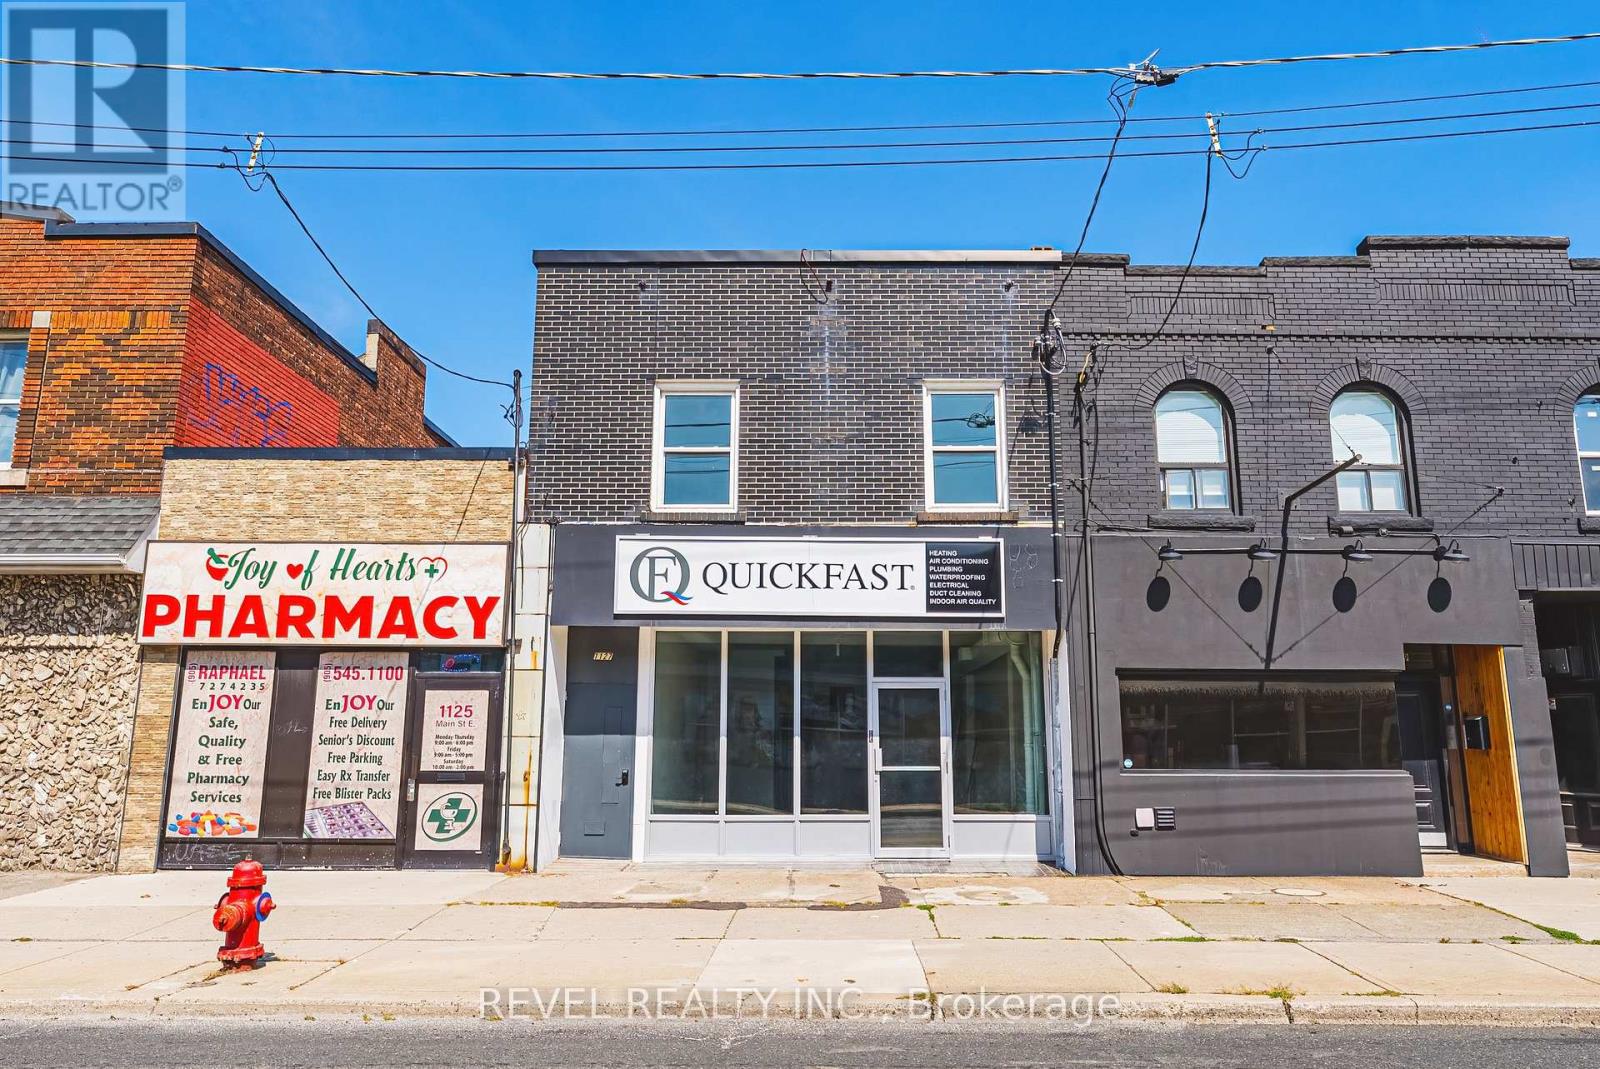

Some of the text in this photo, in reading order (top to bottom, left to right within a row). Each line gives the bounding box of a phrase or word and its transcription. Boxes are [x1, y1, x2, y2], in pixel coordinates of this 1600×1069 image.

[225, 548, 277, 590] Joy
[330, 548, 417, 581] Hearts
[142, 594, 501, 640] PHARMACY
[198, 665, 266, 680] RAPHAEL
[333, 666, 404, 681] 545.1100
[440, 705, 473, 718] 1125
[209, 717, 238, 730] Safe,
[329, 717, 387, 730] Free Delivery
[199, 735, 246, 748] Quality
[318, 734, 395, 746] Senior's Discount
[198, 754, 242, 765] & Free
[328, 752, 383, 765] Free Parking
[187, 772, 249, 786] Pharmacy
[317, 770, 390, 783] Easy Rx Transfer
[190, 791, 242, 803] Services
[313, 788, 391, 799] Free Blister Packs
